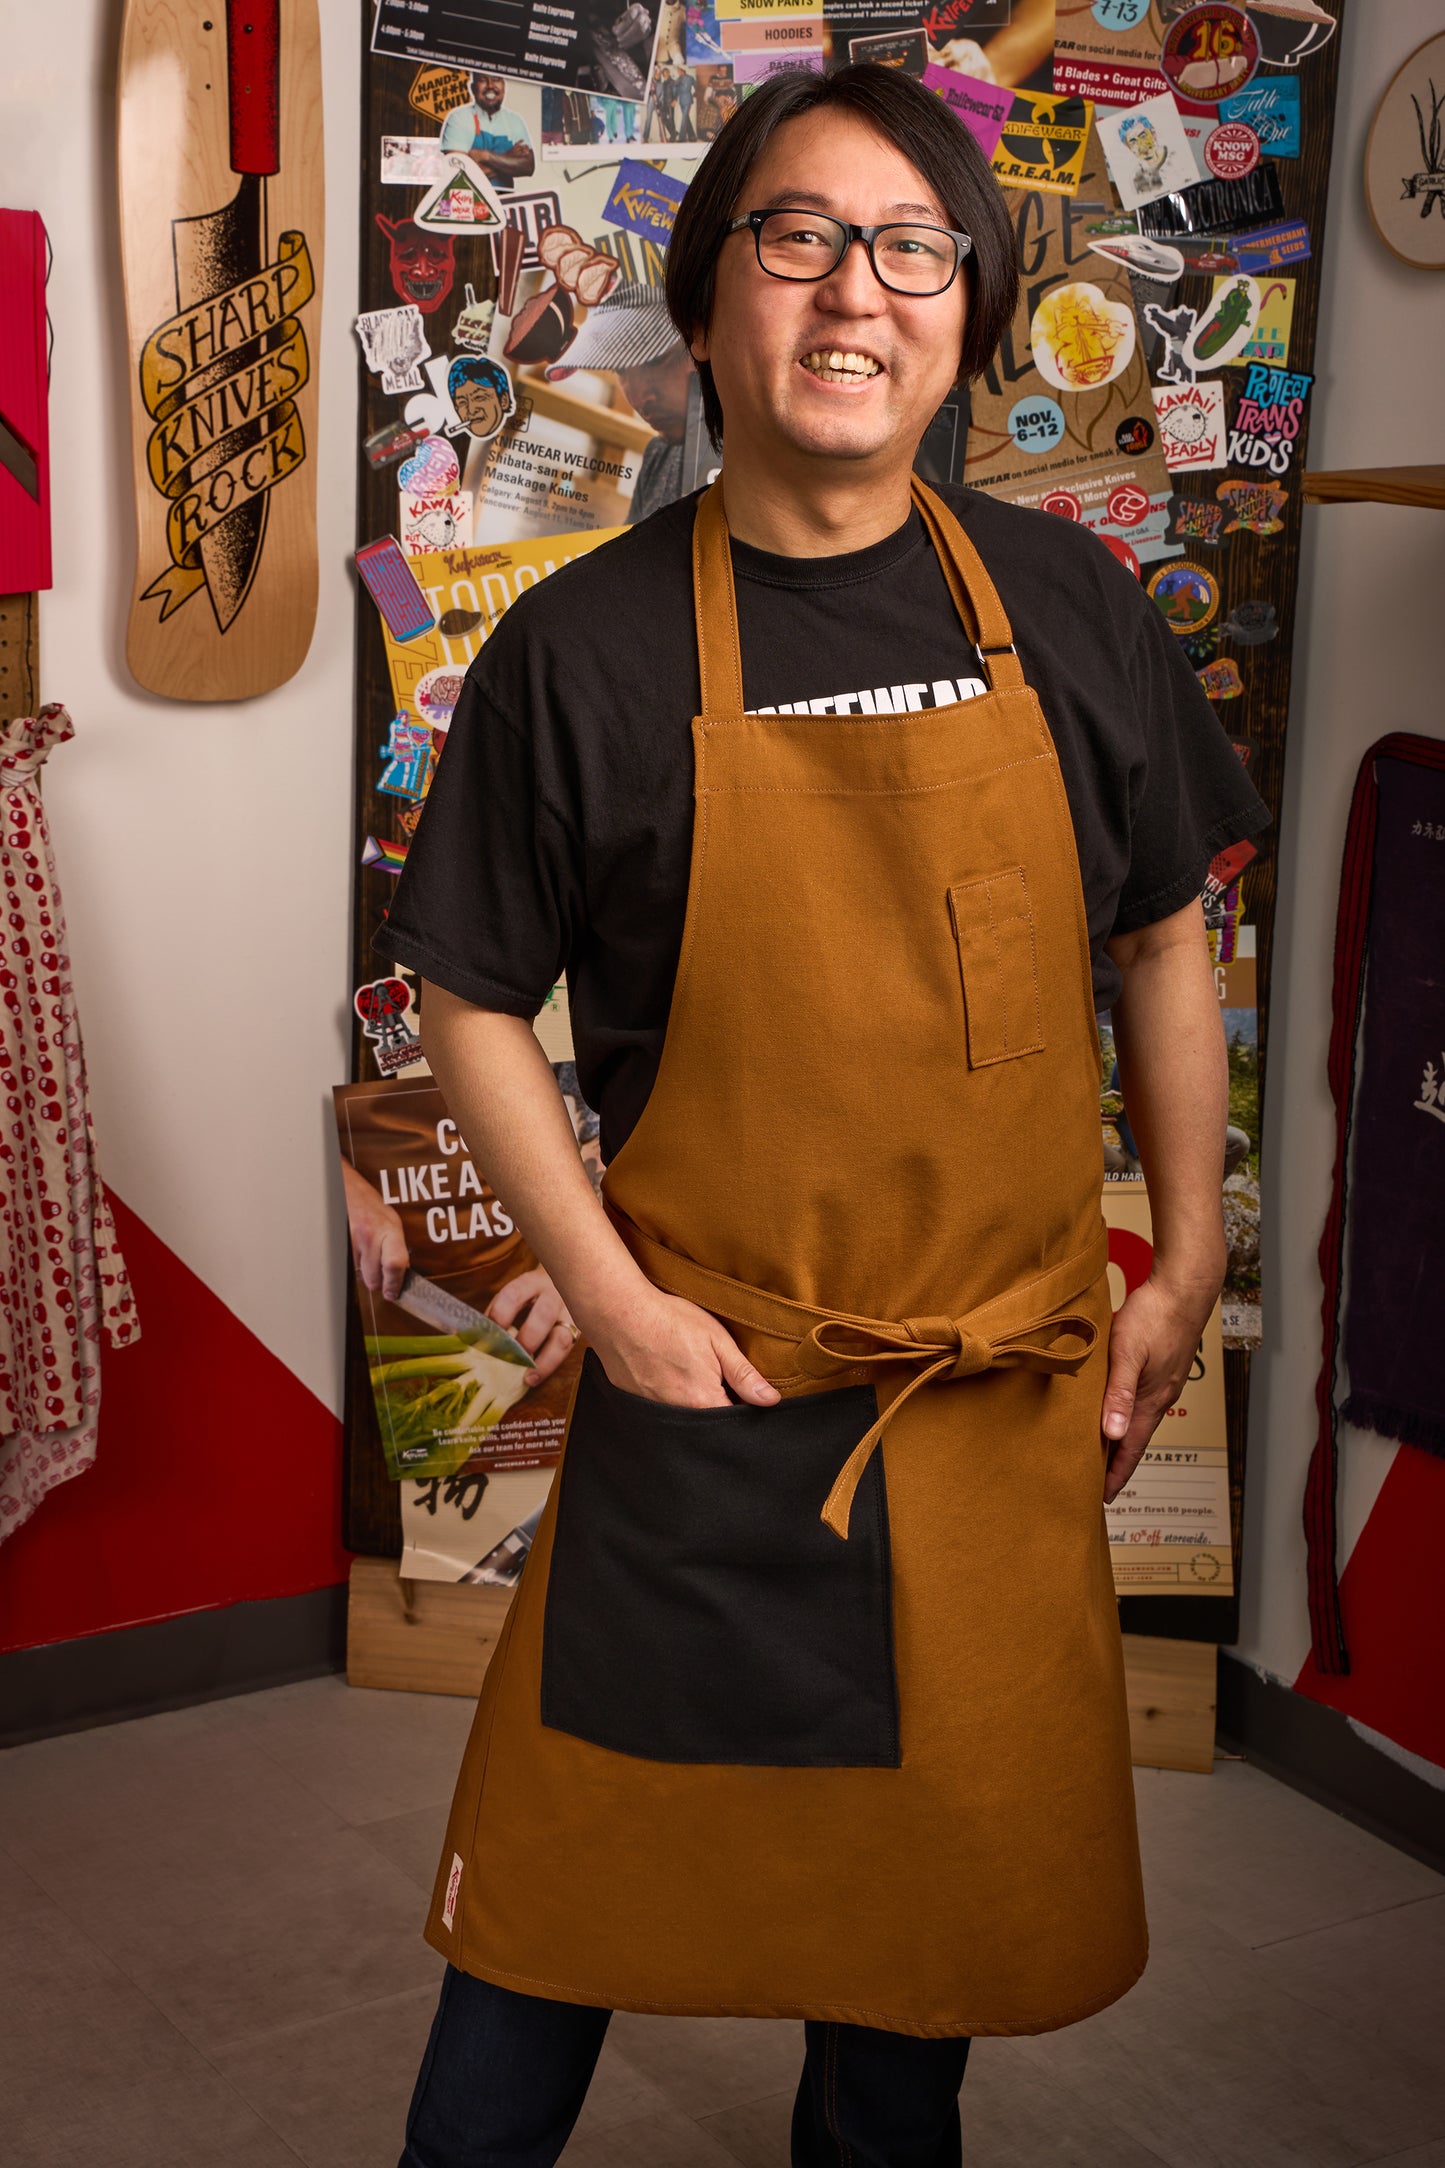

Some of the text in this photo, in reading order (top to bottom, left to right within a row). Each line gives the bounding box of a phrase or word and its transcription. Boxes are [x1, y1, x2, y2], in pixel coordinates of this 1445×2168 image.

[823, 2, 844, 11] ouples
[765, 27, 813, 41] HOODIES
[1193, 20, 1236, 61] 16
[1088, 44, 1114, 55] social
[1116, 48, 1142, 60] media
[1144, 51, 1156, 61] for
[418, 74, 460, 94] HANDS
[1065, 66, 1101, 83] Blades
[1112, 73, 1141, 88] Great
[1143, 76, 1168, 91] Gifts
[415, 93, 430, 104] MY
[1078, 83, 1137, 101] Discounted
[434, 92, 471, 114] KNIV
[1213, 141, 1253, 152] KNOW
[1217, 151, 1246, 161] MSG
[612, 182, 675, 230] KNIFEW
[156, 263, 301, 394] SHARP
[385, 371, 422, 391] METAL
[1245, 364, 1312, 409] PROTECT
[158, 343, 300, 486] KNIVES
[1015, 410, 1056, 429] NOV.
[1235, 398, 1303, 440] TRANS
[487, 450, 573, 482] Shibata-san of
[492, 435, 633, 480] KNIFEWEAR WELCOMES
[1011, 471, 1021, 480] on
[1023, 465, 1048, 478] social
[1050, 458, 1075, 471] media
[1076, 455, 1088, 465] for
[1090, 450, 1114, 461] sneak
[174, 423, 300, 554] ROCK
[484, 466, 589, 503] Masakage Knives
[1016, 493, 1039, 505] New
[1058, 475, 1103, 493] Exclusive
[1104, 470, 1136, 485] Knives
[1083, 488, 1112, 502] More!
[380, 1160, 483, 1204] LIKE A
[426, 1200, 519, 1243] CLAS
[501, 1420, 533, 1431] confident
[534, 1418, 550, 1427] with
[525, 1429, 538, 1437] and
[496, 1443, 513, 1452] team
[515, 1442, 524, 1450] for
[525, 1441, 543, 1449] more
[1145, 1453, 1198, 1462] PARTY!
[1181, 1507, 1215, 1516] people.
